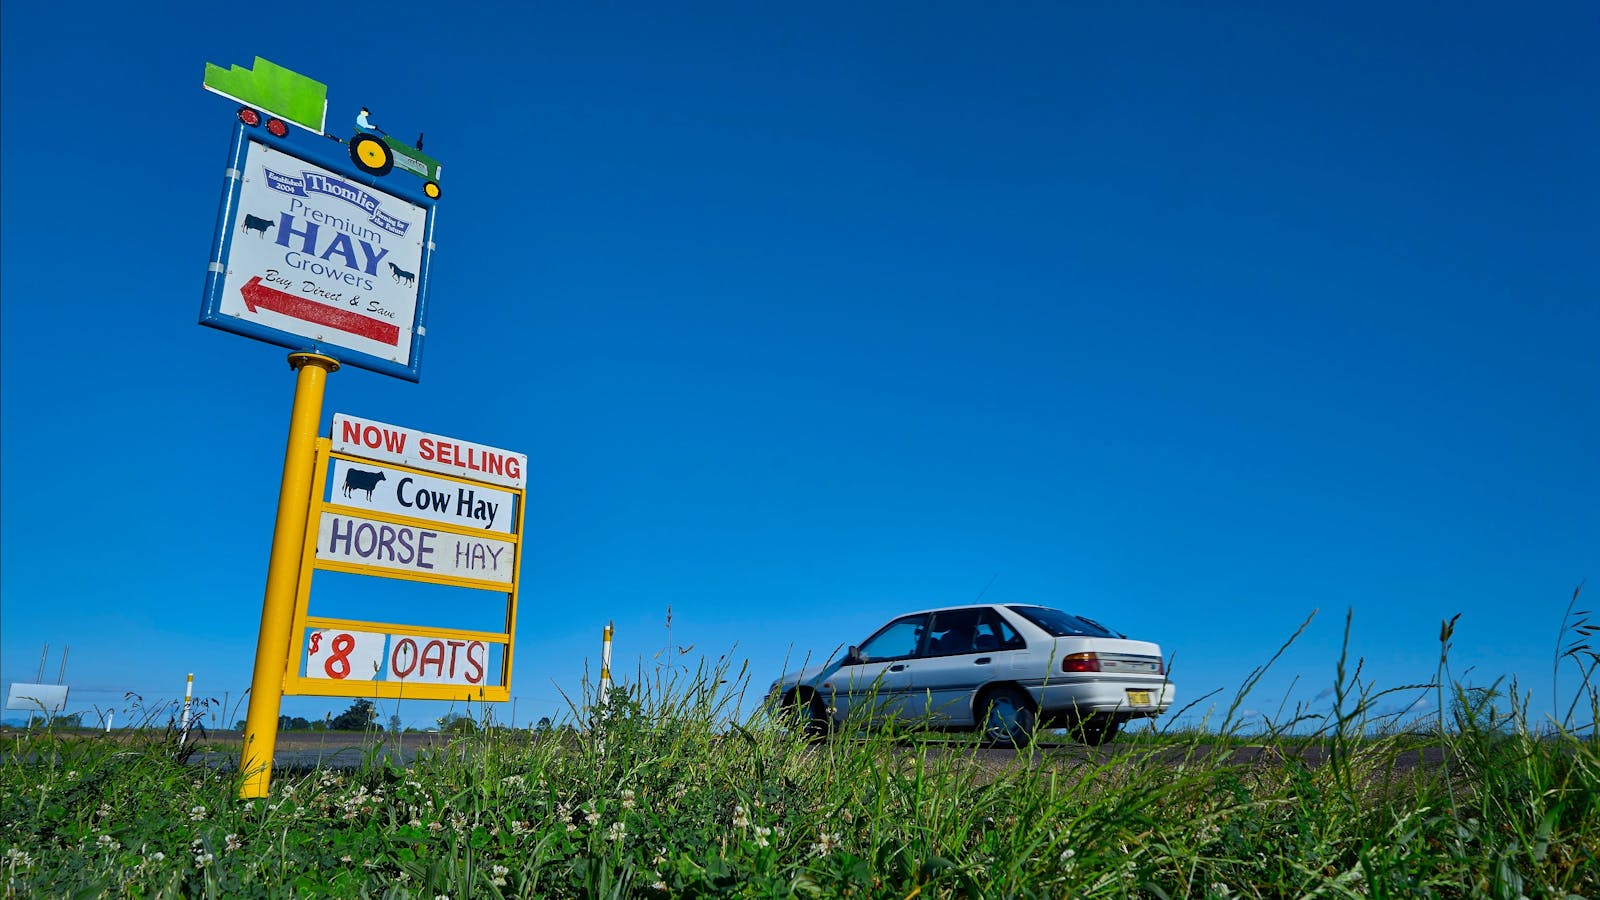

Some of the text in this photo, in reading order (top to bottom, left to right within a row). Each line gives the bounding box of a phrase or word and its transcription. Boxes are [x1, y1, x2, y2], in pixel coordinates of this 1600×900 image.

[306, 173, 375, 211] Thomlie
[275, 211, 389, 277] HAY
[290, 198, 382, 244] Premium
[265, 269, 396, 319] Buy Direct & Save
[285, 251, 373, 291] Growers
[342, 420, 521, 479] NOW SELLING
[396, 477, 499, 529] Cow Hay
[329, 518, 504, 571] HORSE HAY
[391, 637, 485, 684] OATS
